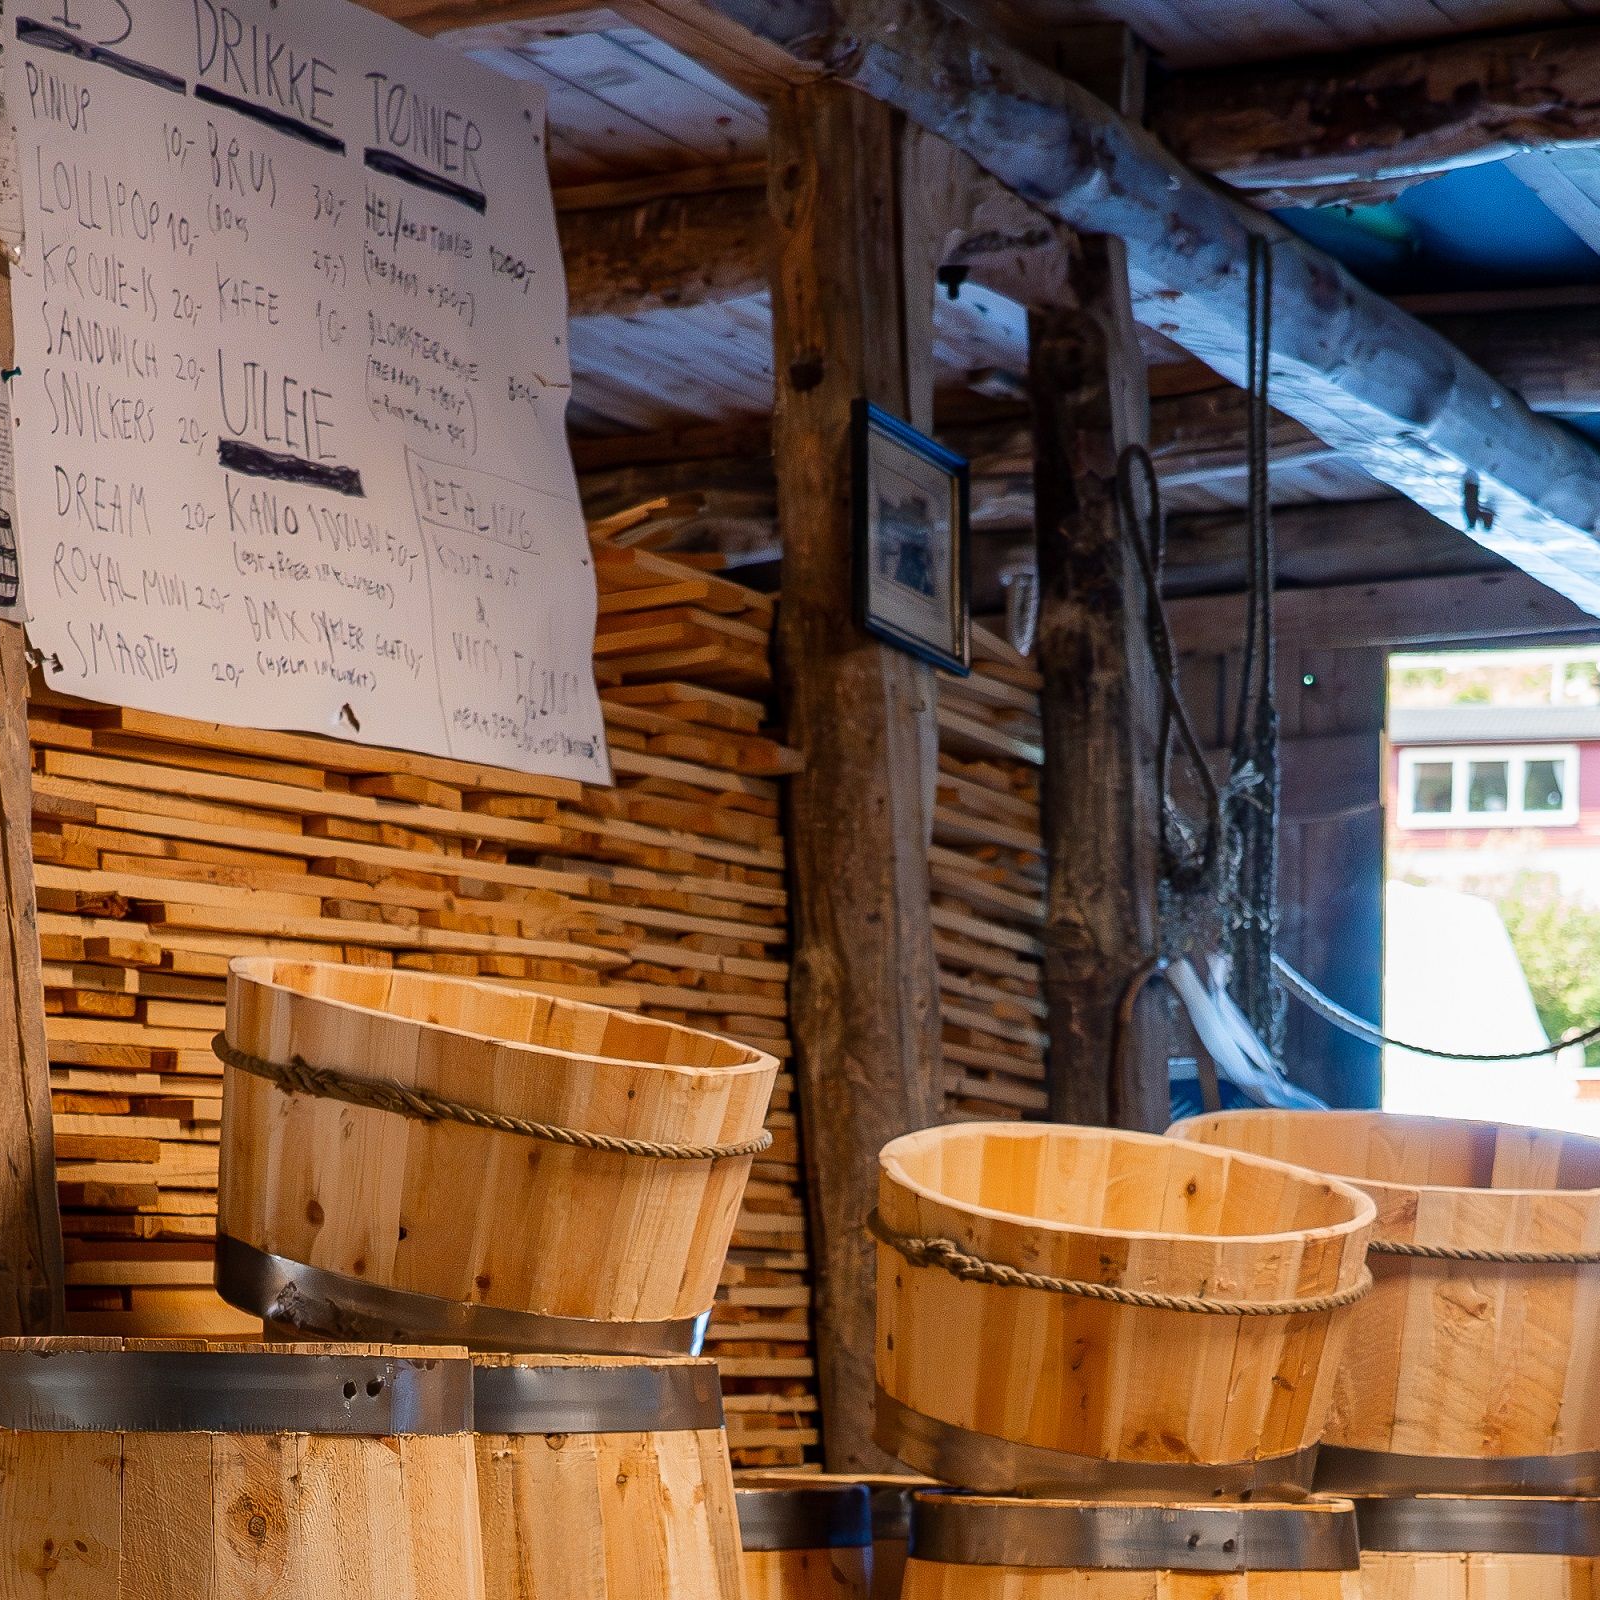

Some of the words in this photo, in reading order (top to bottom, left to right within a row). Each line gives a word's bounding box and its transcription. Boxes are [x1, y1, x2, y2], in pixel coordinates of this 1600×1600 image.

[25, 61, 90, 134] PINUP
[193, 0, 337, 128] DRIKKE
[207, 120, 276, 208] BRUS
[365, 72, 484, 190] TØNNER
[37, 145, 159, 243] LOLLIPOP
[215, 261, 279, 325] KAFFE
[42, 301, 158, 378] SANDWICH
[44, 368, 155, 443] SNICKERS
[218, 348, 336, 459] UTLEIE
[54, 464, 151, 537] DREAM
[225, 473, 299, 536] KANO
[53, 541, 137, 607] ROYAL
[142, 569, 189, 611] MINI
[66, 620, 178, 682] SMARTIES
[244, 595, 311, 644] BMX
